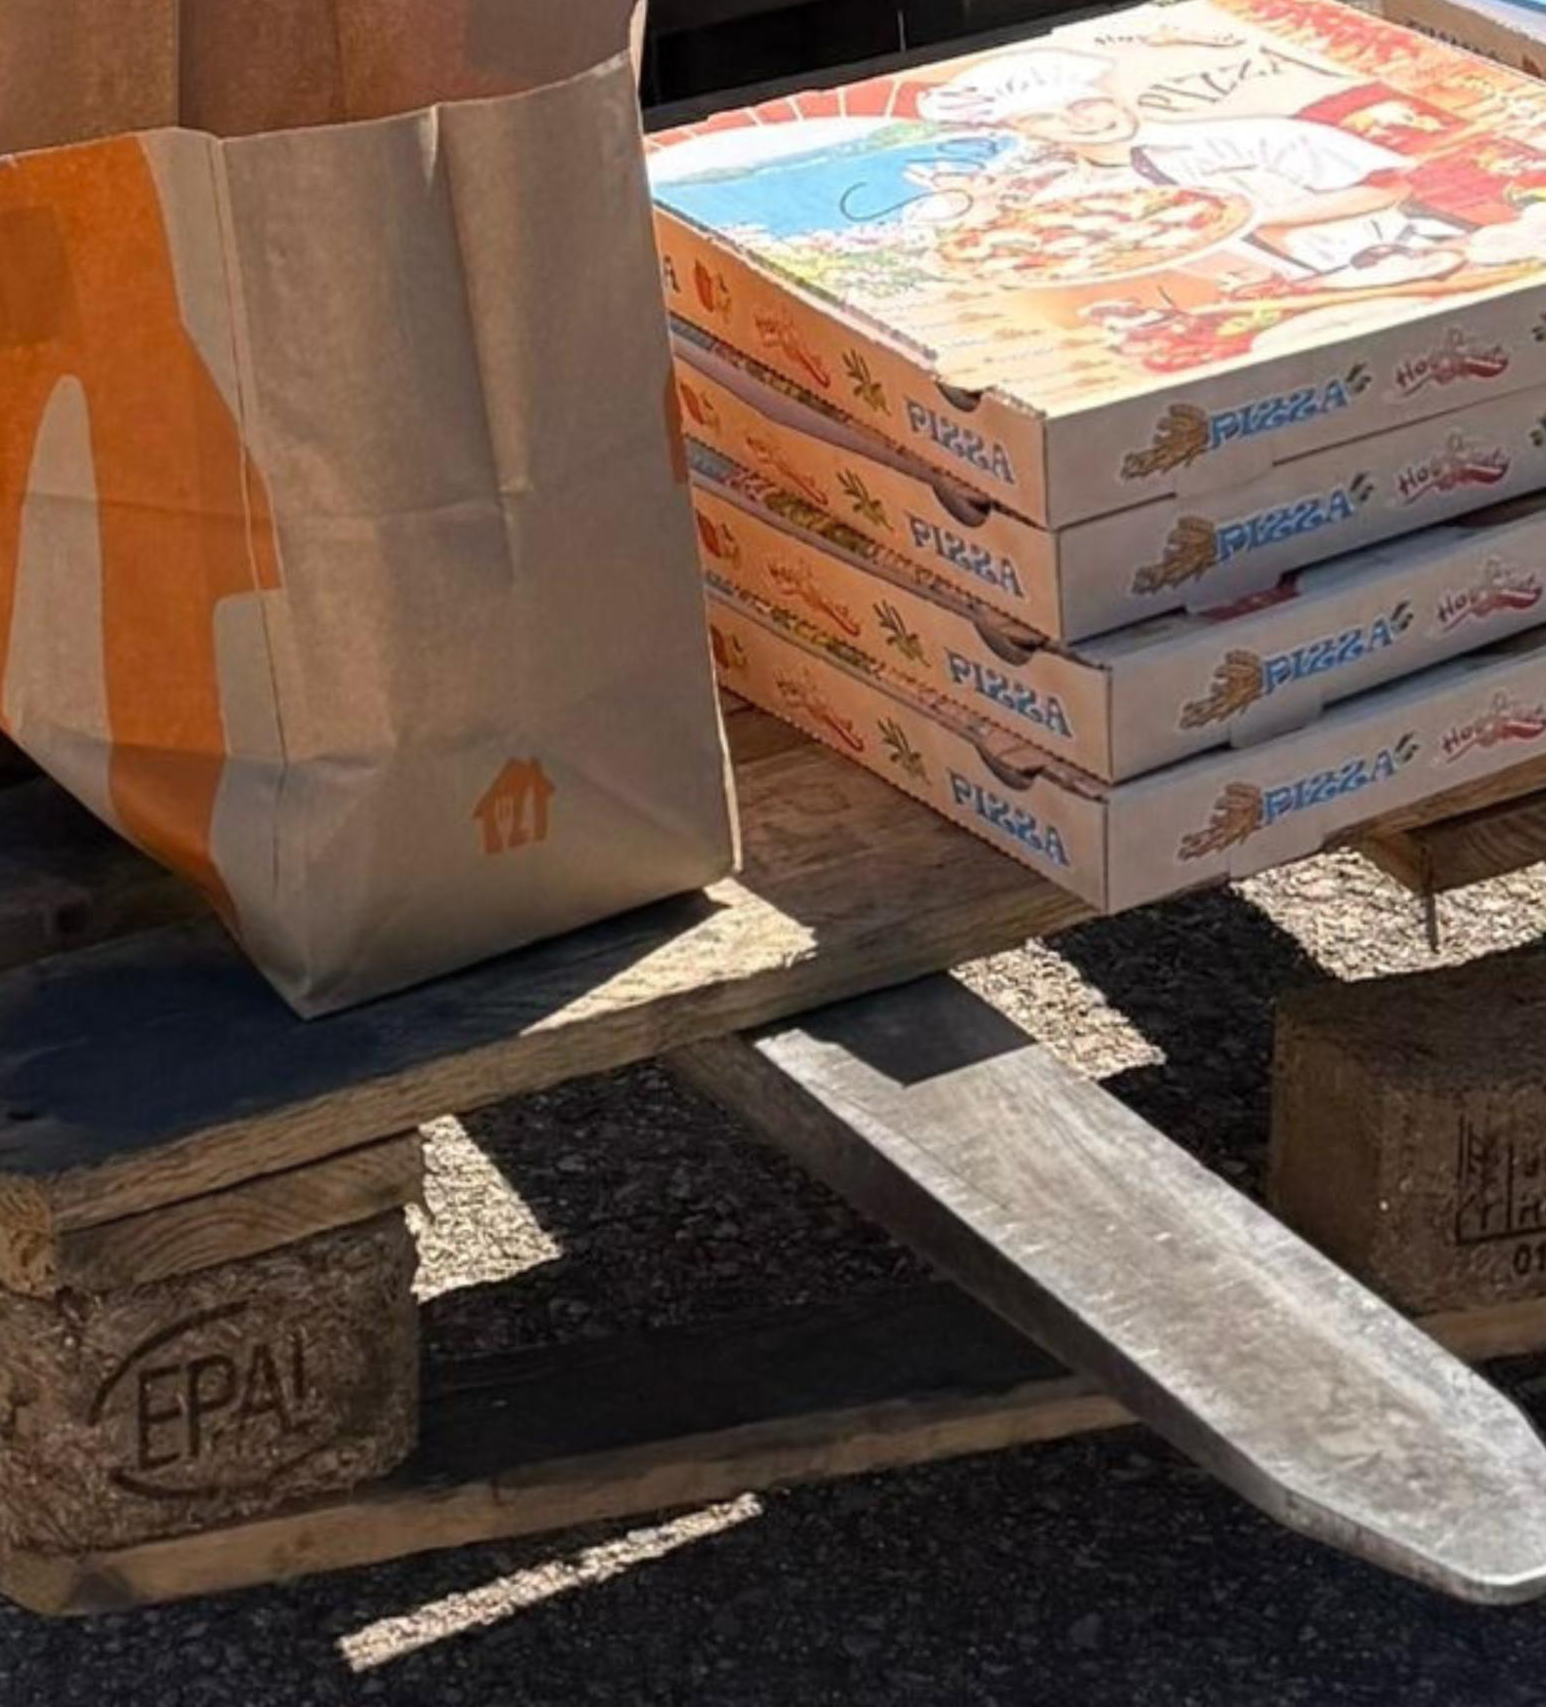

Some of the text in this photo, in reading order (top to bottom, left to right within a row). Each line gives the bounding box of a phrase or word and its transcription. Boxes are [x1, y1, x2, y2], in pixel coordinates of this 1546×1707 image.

[908, 398, 1015, 486] PIZZA
[1209, 379, 1353, 449] PIZZA
[911, 516, 1025, 599] PIZZA
[1216, 489, 1356, 563] PIZZA
[948, 648, 1073, 739] PIZZA
[1265, 618, 1395, 693] PIZZA
[954, 771, 1070, 868] PIZZA
[1265, 751, 1399, 822] PIZZA
